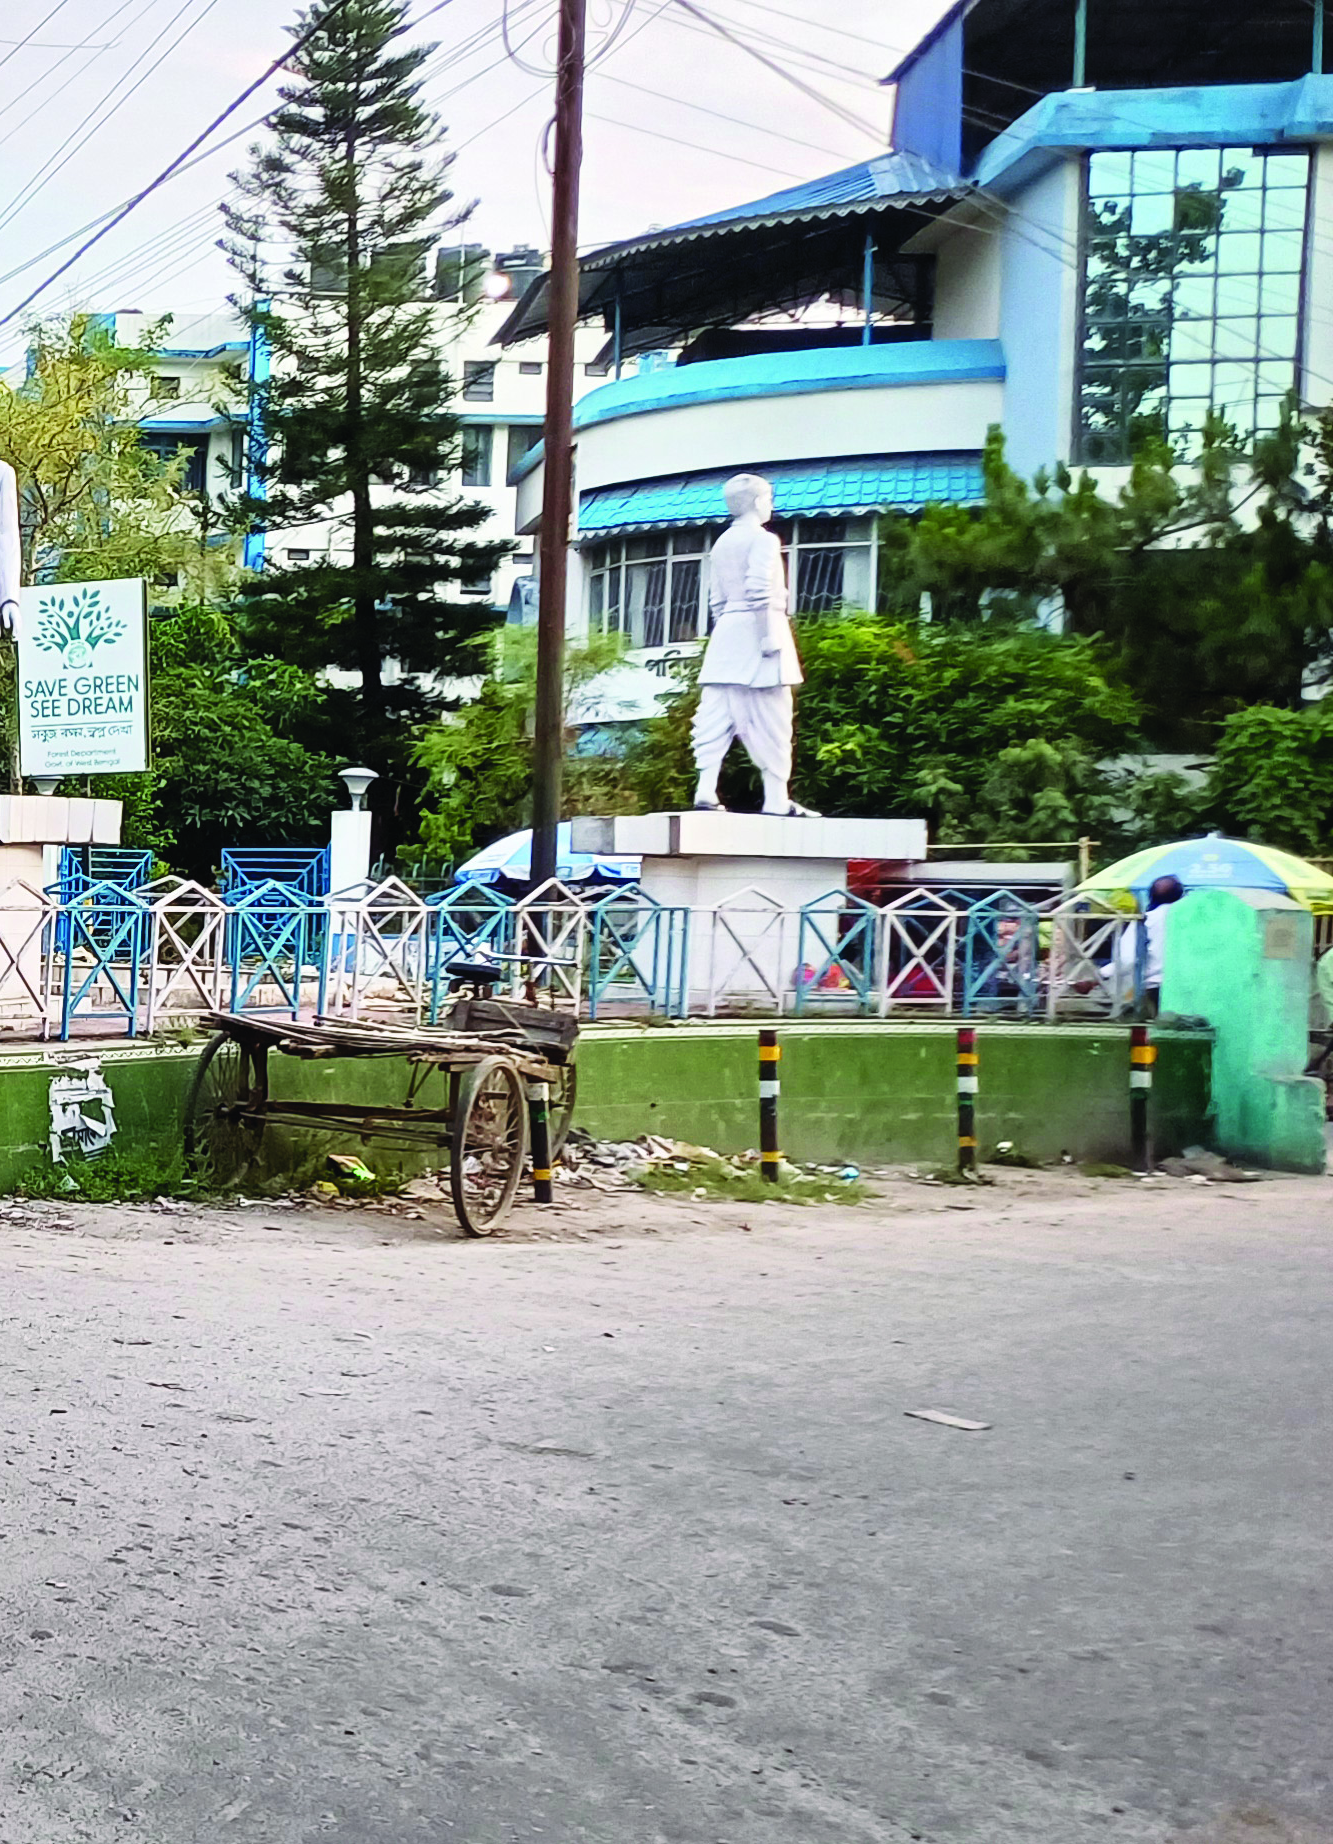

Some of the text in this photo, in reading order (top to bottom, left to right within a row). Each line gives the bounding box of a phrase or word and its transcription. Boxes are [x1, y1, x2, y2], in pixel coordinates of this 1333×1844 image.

[24, 674, 139, 698] SAVE GREEN
[30, 695, 133, 718] SEE DREAM
[71, 748, 116, 758] Department
